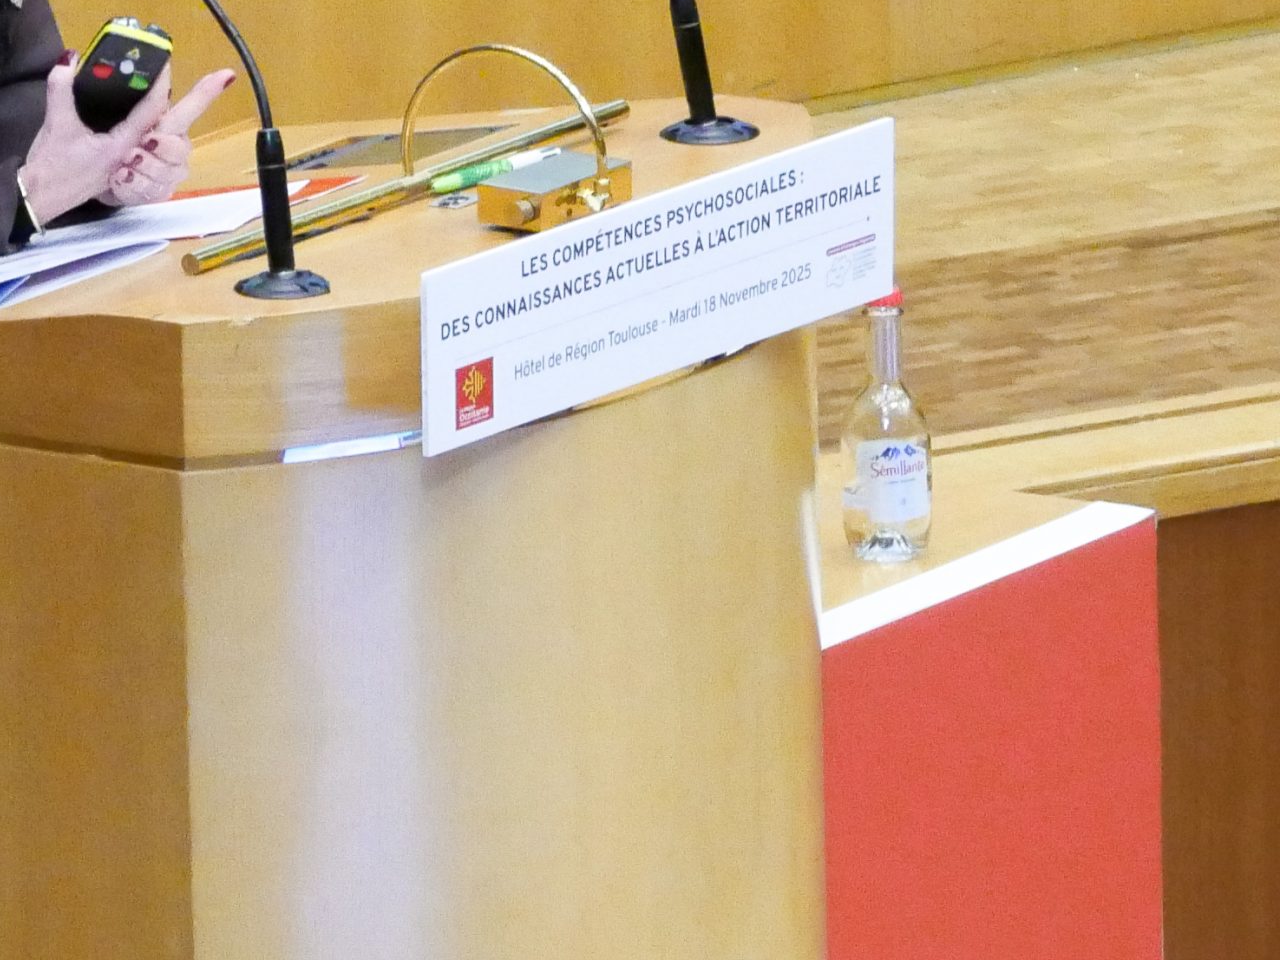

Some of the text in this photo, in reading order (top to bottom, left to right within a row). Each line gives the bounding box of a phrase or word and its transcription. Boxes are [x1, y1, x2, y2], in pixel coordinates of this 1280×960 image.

[441, 175, 881, 340] DES CONNAISSANCES ACTUELLES À L'ACTION TERRITORIALE
[521, 253, 548, 277] LES
[553, 215, 662, 266] COMPÉTENCES
[667, 169, 797, 228] PSYCHOSOCIALES
[515, 357, 545, 380] Hôtel
[548, 353, 562, 368] de
[566, 337, 605, 362] Région
[608, 318, 658, 347] Toulouse
[669, 301, 701, 326] Mardi
[704, 296, 716, 316] 18
[720, 278, 778, 308] Novembre
[781, 263, 812, 288] 2025
